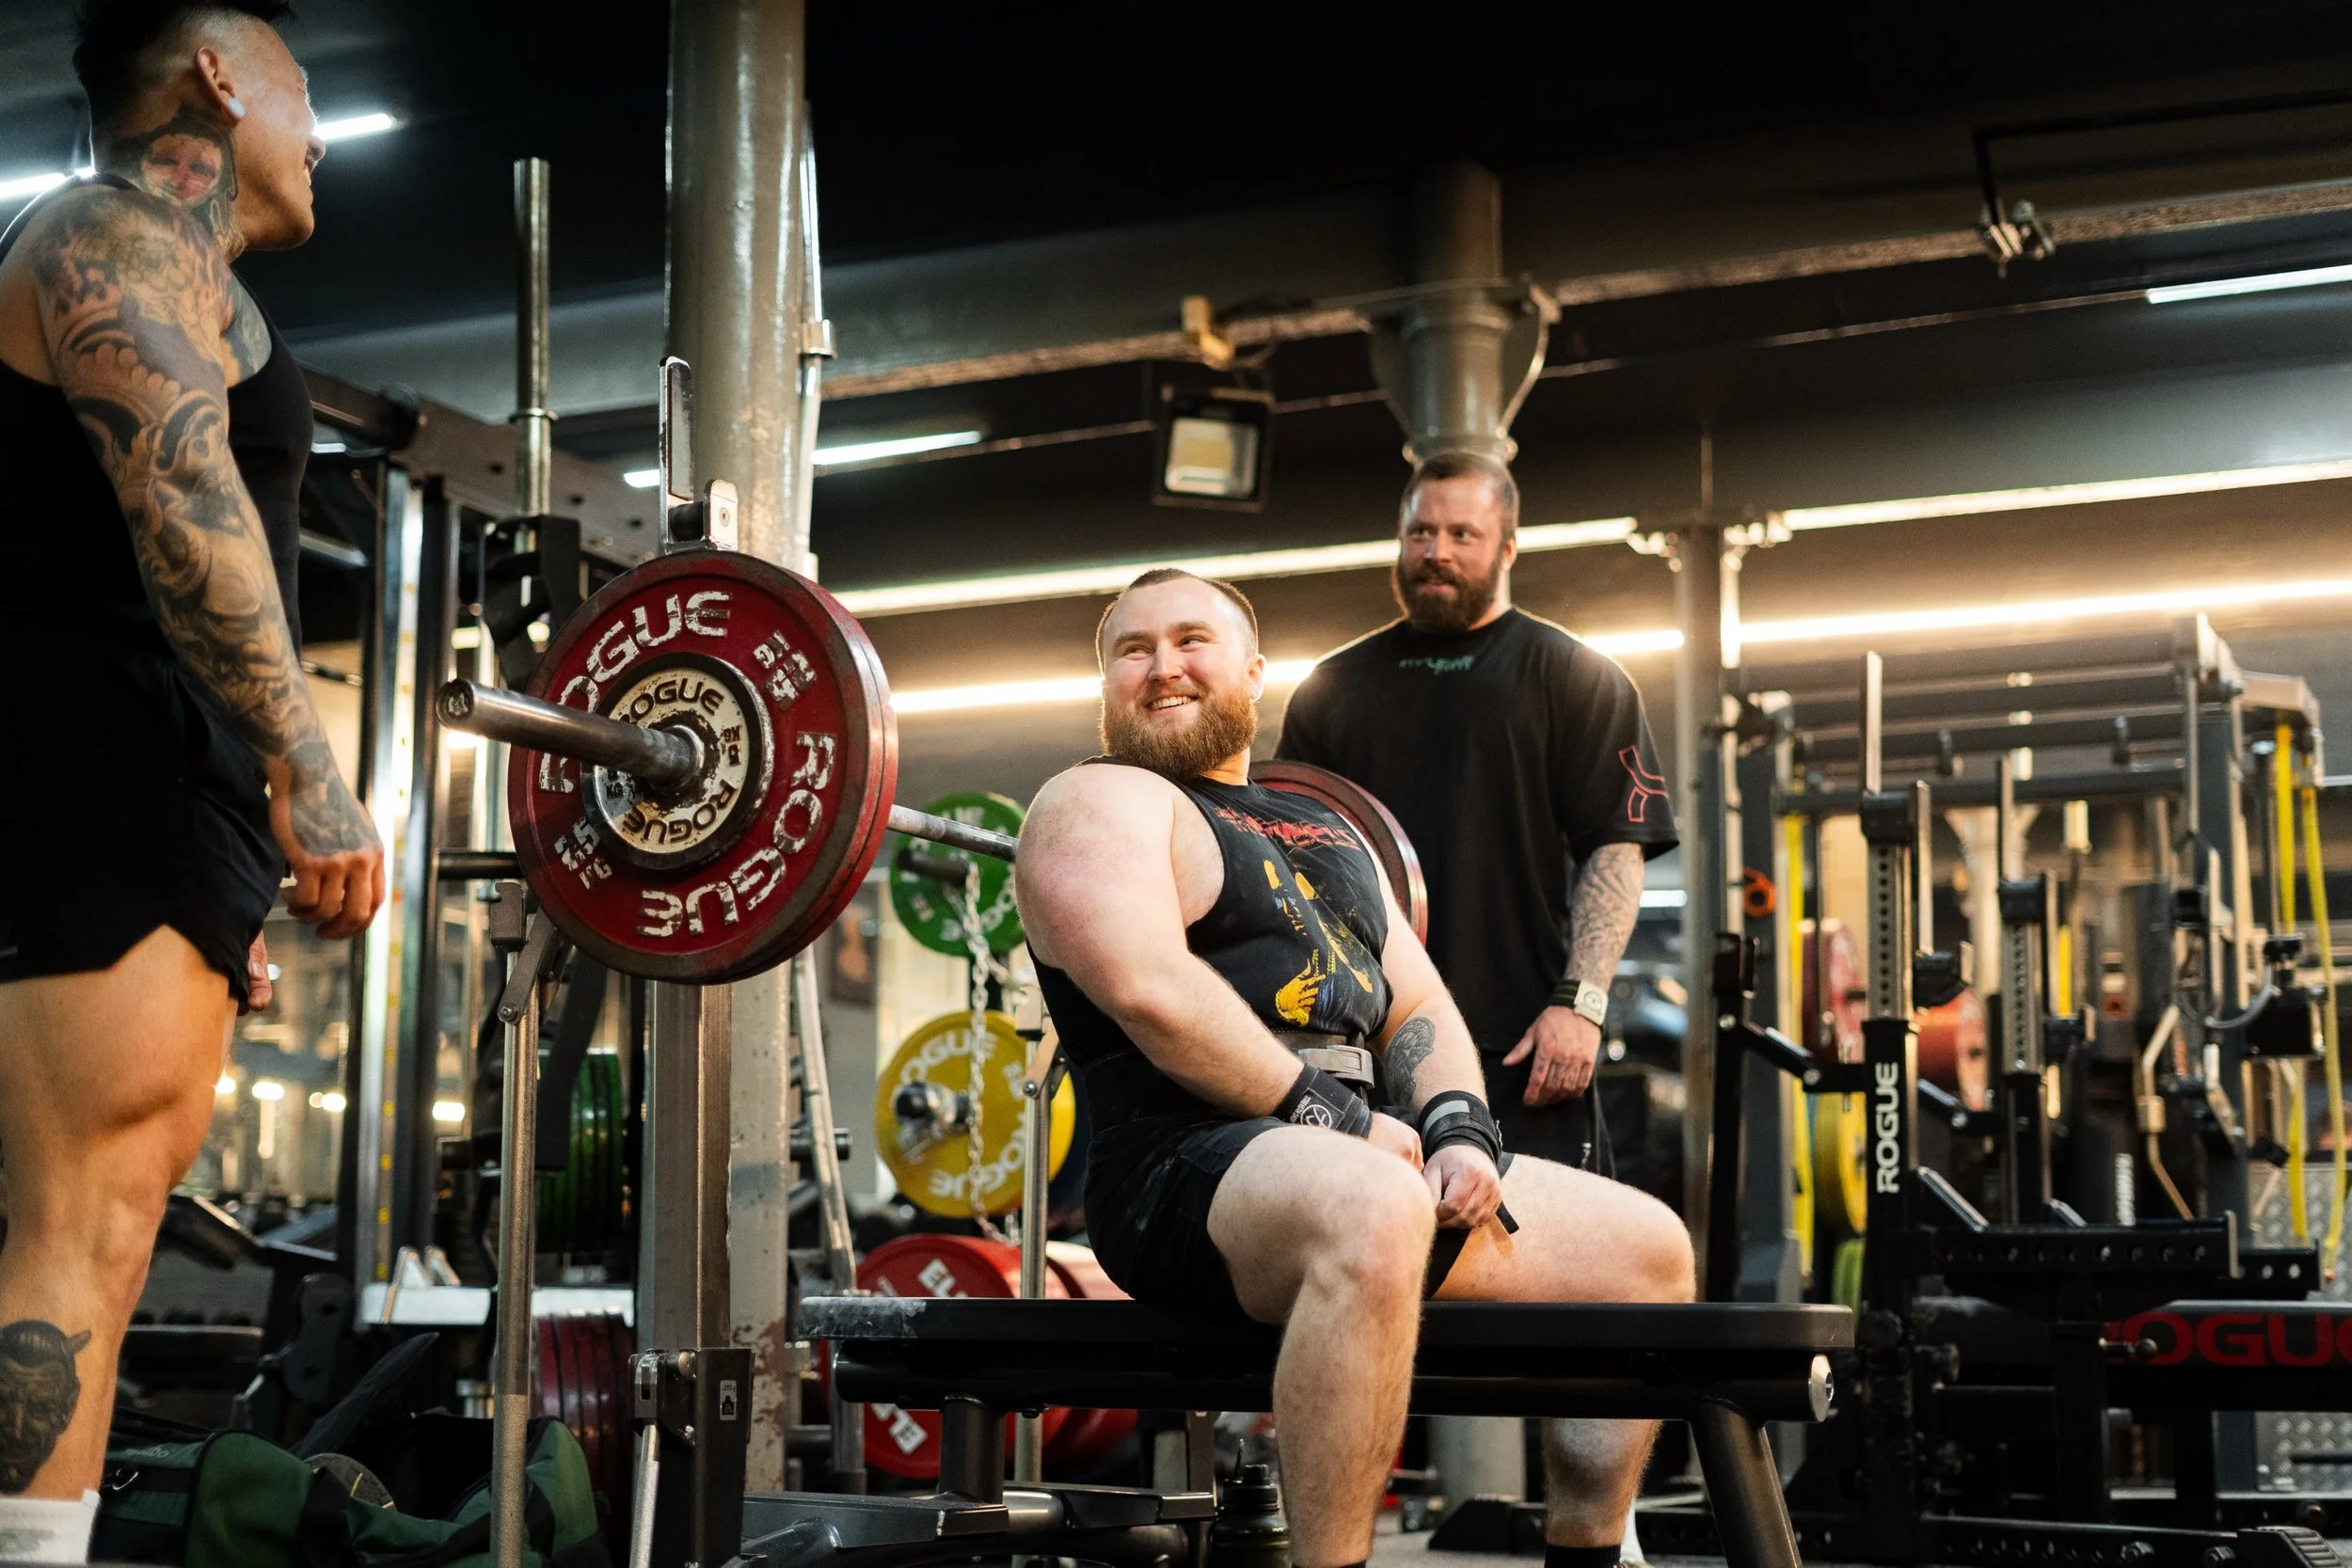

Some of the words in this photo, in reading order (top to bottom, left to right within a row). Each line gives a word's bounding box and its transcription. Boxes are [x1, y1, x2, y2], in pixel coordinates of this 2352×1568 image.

[754, 629, 791, 670] KG
[619, 678, 724, 723] OGUE
[765, 650, 818, 711] 25
[723, 725, 742, 742] KG
[622, 779, 738, 845] ROGUE
[636, 731, 836, 937] ROGUE
[553, 816, 600, 872] 25
[899, 1029, 998, 1087] OGUE
[1875, 1061, 1900, 1194] ROGUE
[2101, 1311, 2352, 1367] OGU
